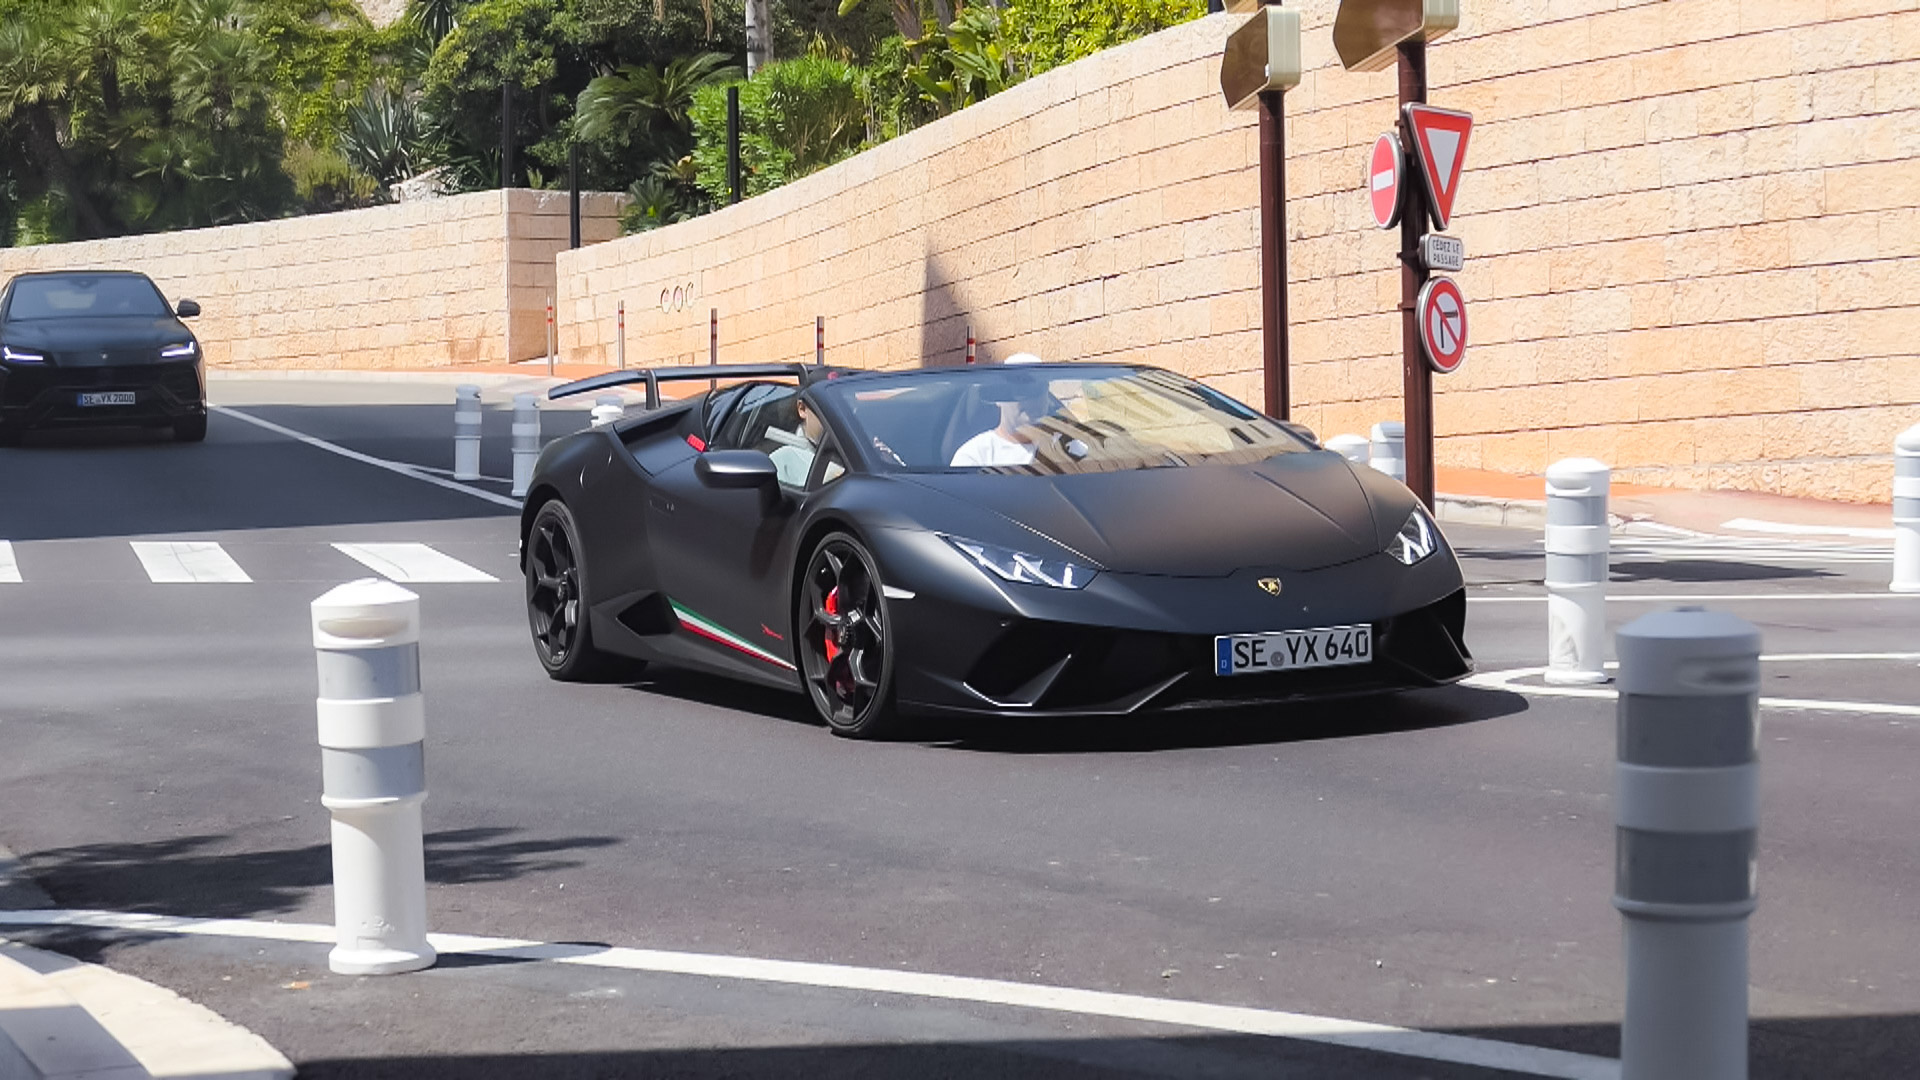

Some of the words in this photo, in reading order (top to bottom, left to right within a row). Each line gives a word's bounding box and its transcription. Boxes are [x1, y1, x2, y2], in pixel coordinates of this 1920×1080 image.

[1452, 242, 1460, 254] LE
[1433, 253, 1459, 267] PASSAGE
[1233, 639, 1268, 669] SE
[1286, 635, 1319, 665] YX
[1324, 629, 1369, 661] 640
